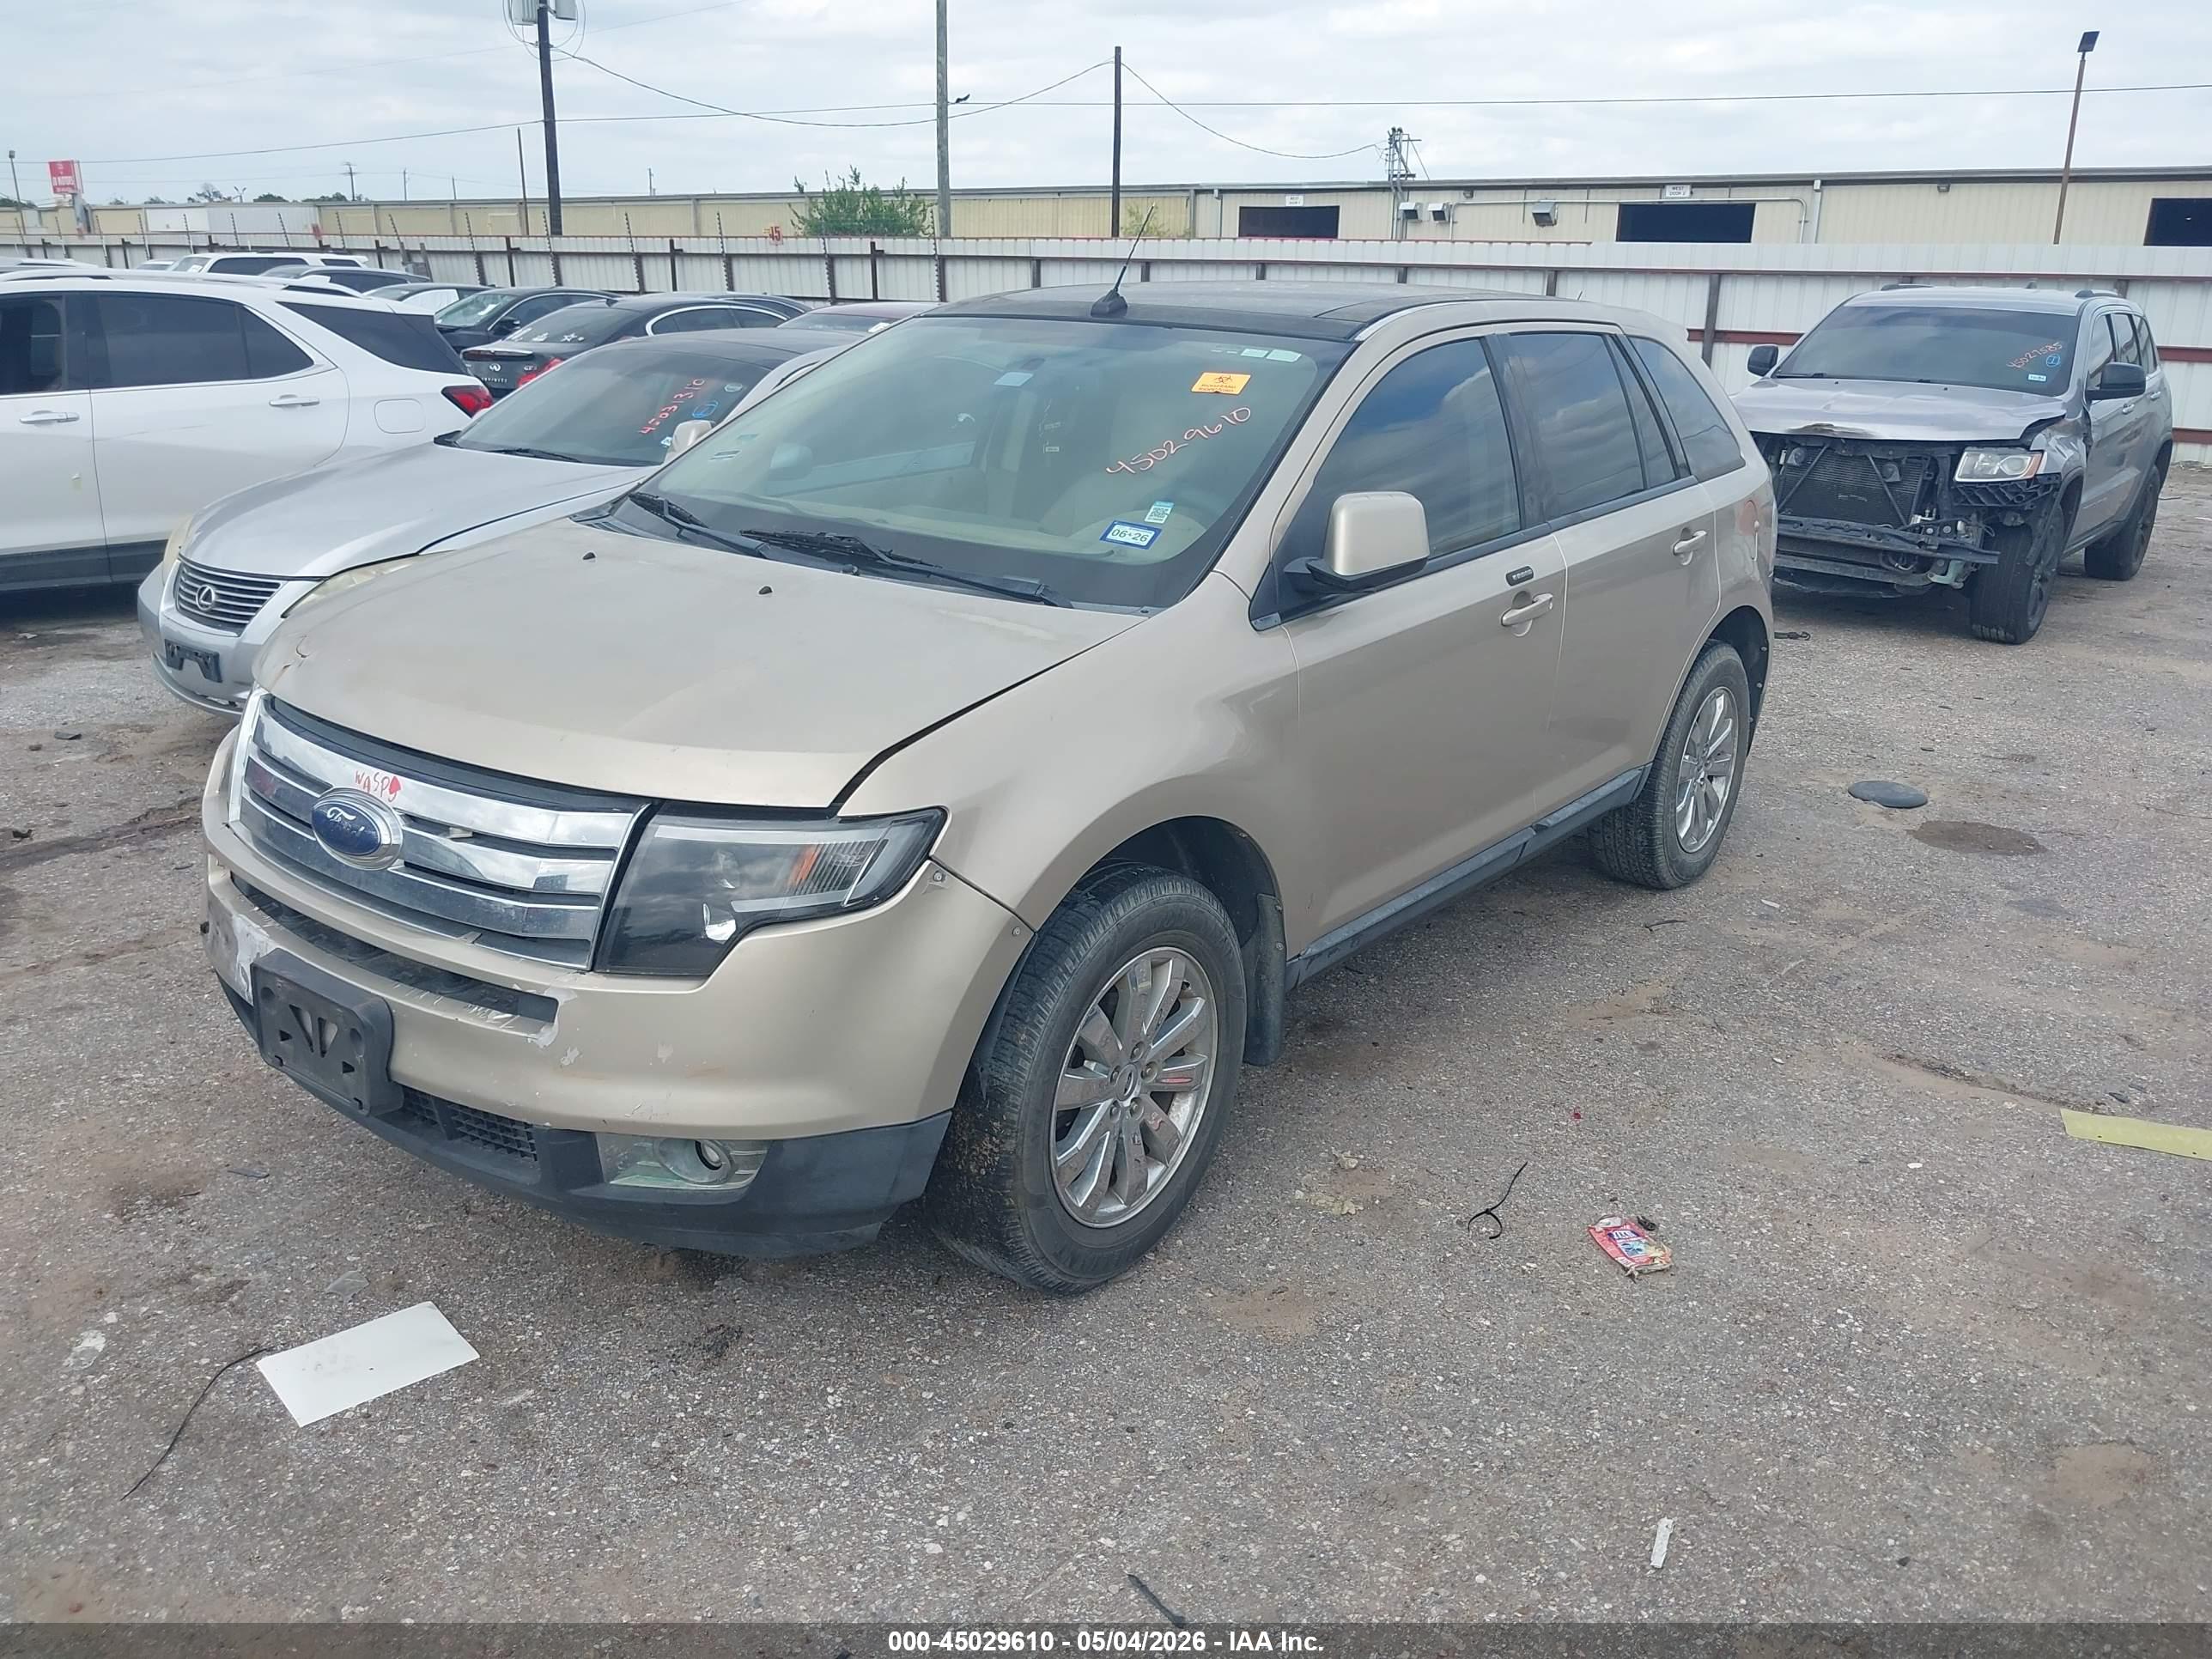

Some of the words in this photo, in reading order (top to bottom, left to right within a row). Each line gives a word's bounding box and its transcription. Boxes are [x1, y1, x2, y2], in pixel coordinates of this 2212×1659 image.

[1106, 407, 1251, 474] 45029610
[1111, 528, 1127, 538] 06
[1132, 532, 1149, 542] 26
